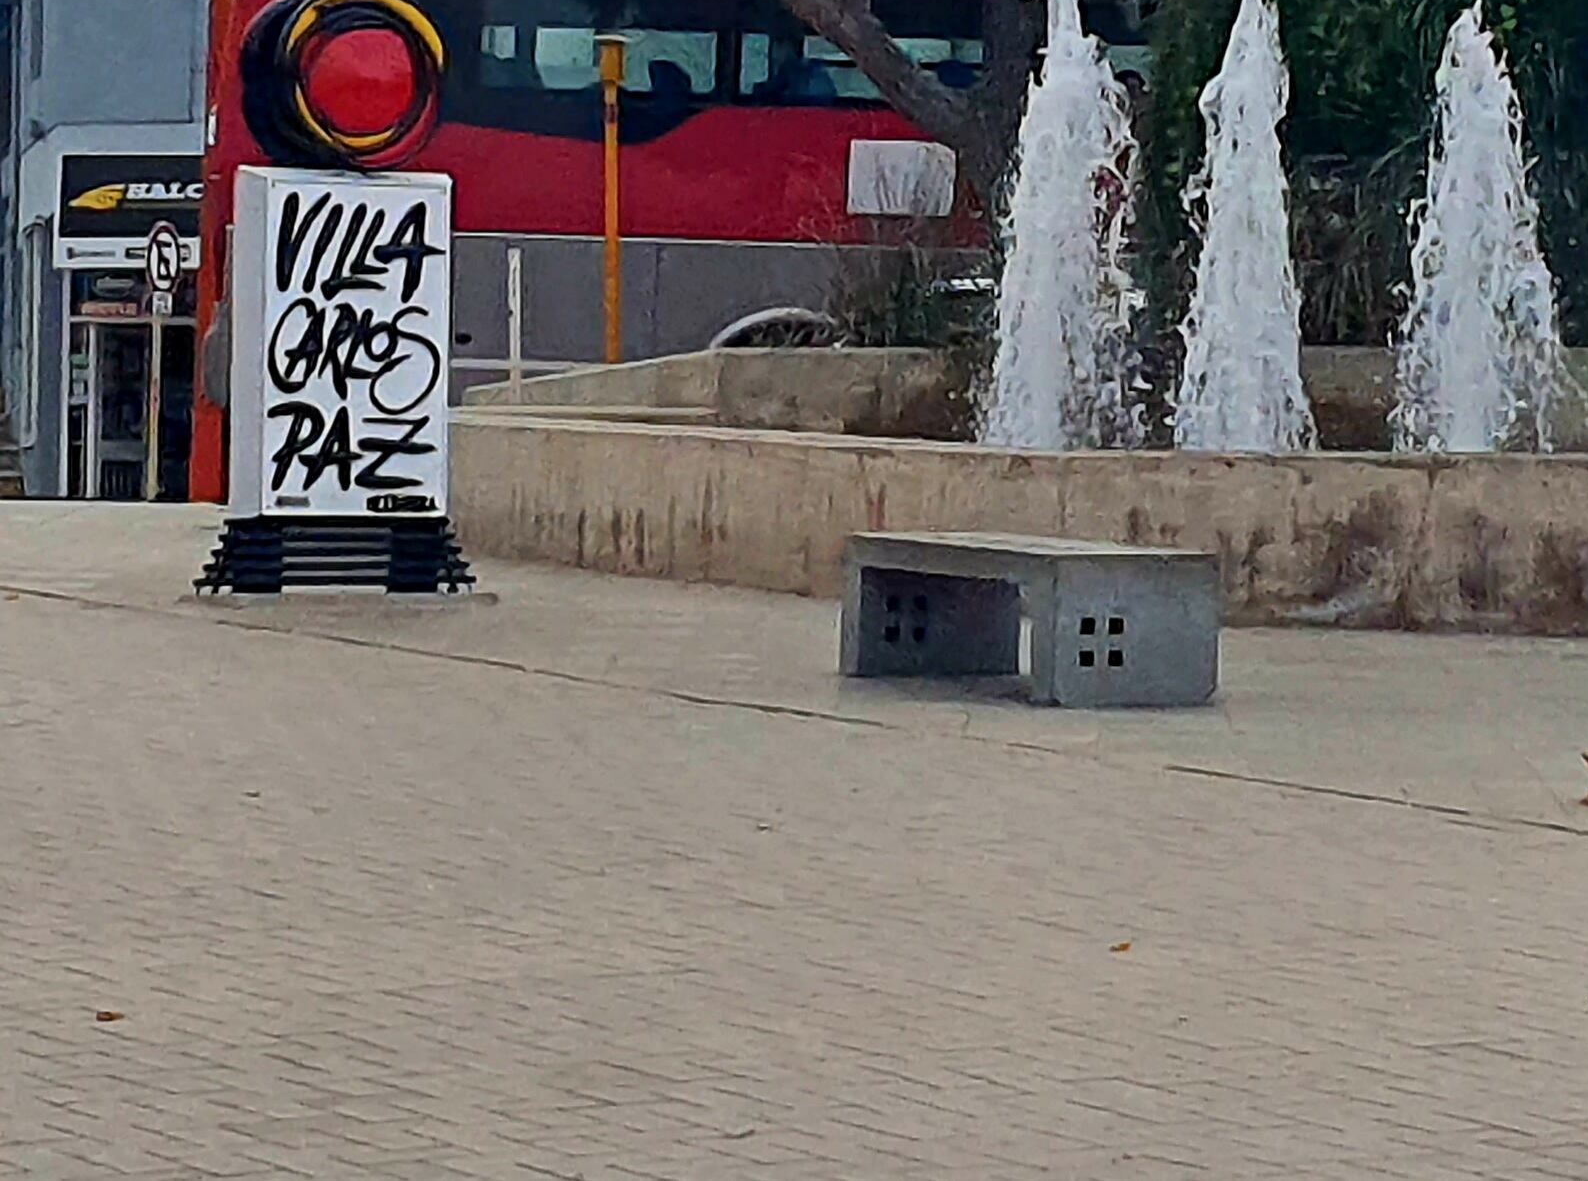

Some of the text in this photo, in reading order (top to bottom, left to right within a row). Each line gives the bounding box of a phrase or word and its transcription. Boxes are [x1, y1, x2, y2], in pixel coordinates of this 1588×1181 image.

[276, 191, 446, 303] VILLA
[267, 297, 440, 415] CARLOS
[267, 401, 437, 491] PAZ
